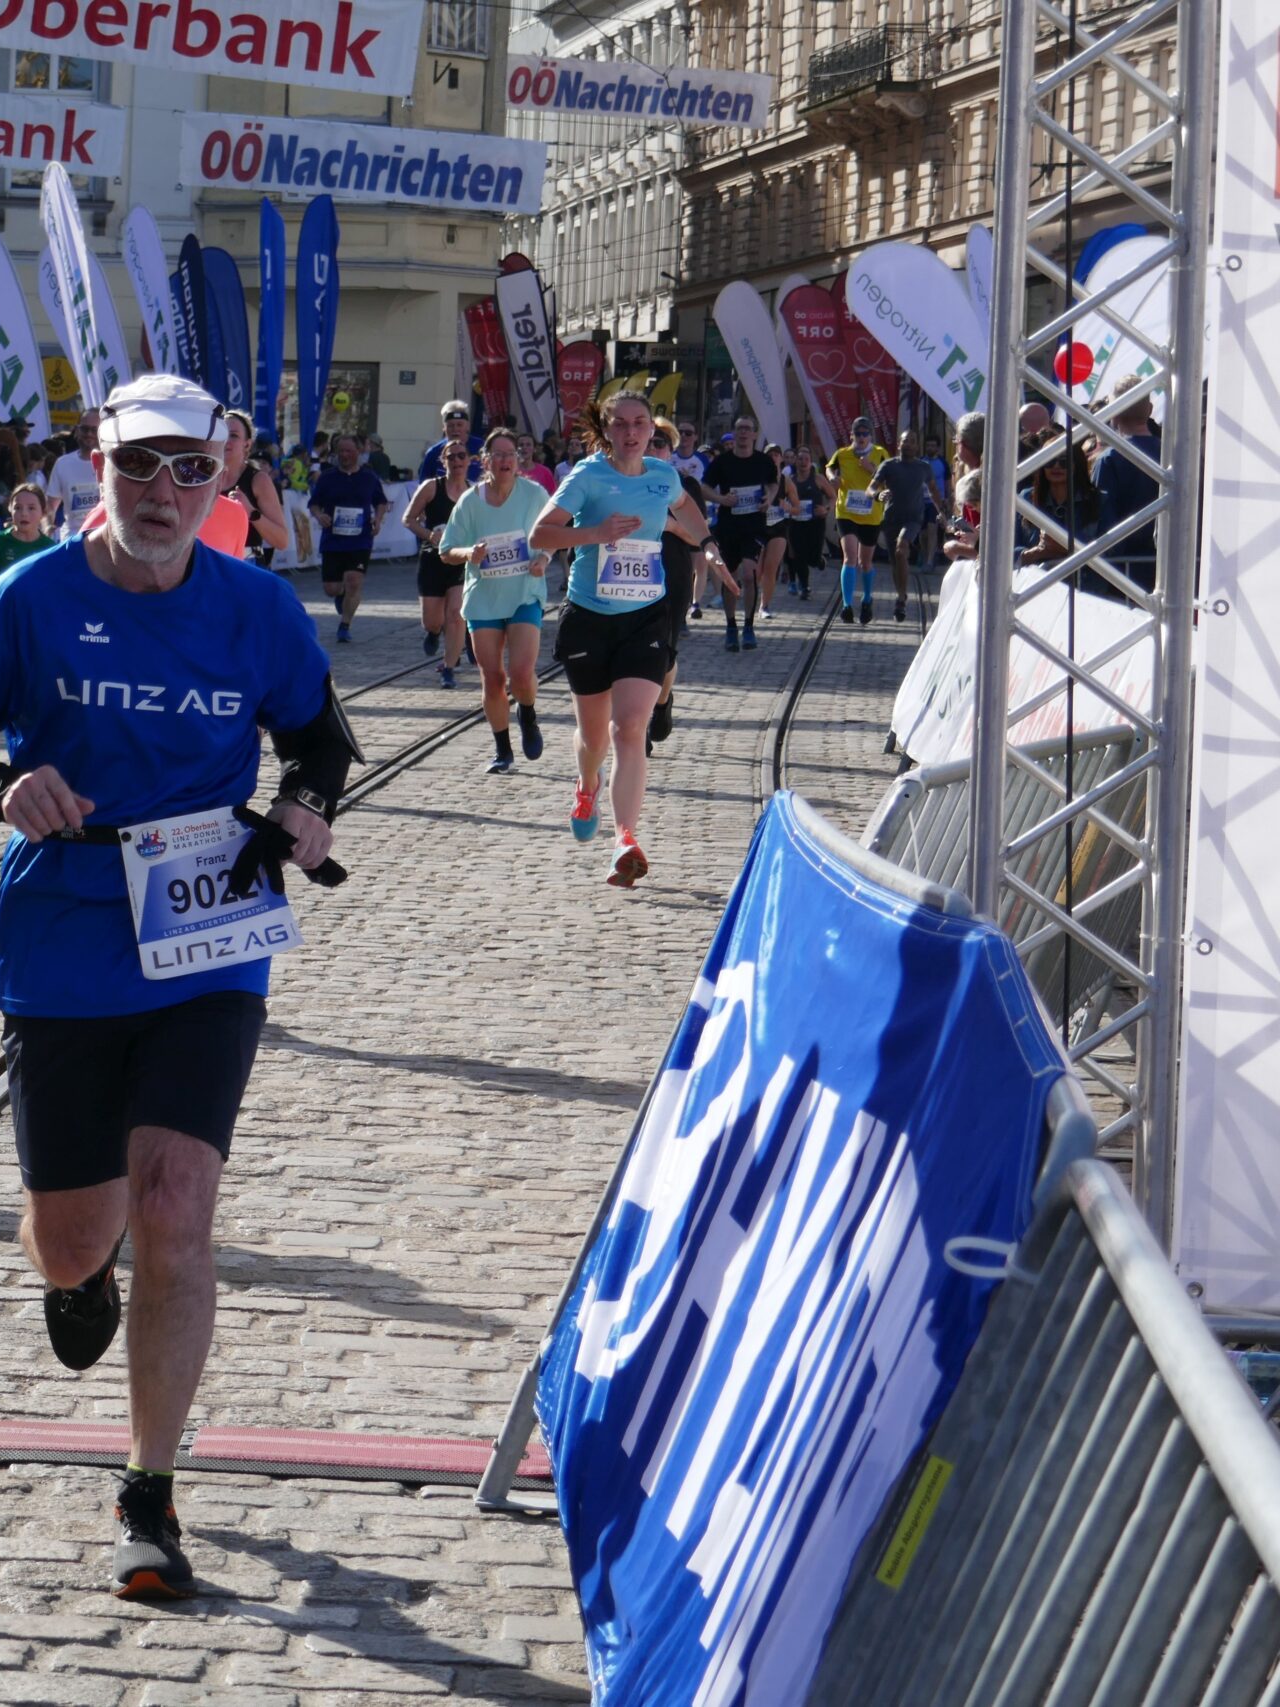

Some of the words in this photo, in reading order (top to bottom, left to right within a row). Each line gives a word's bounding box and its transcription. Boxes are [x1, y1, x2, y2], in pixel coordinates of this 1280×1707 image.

[508, 61, 754, 123] OÖNachrichten
[200, 122, 523, 205] OÖNachrichten
[562, 371, 592, 381] ORF
[485, 548, 520, 564] 13537
[613, 562, 650, 578] 9165
[601, 587, 635, 597] LINZ
[638, 590, 657, 598] AG
[79, 633, 110, 643] erima
[56, 678, 166, 712] LINZ
[176, 689, 243, 716] AG
[171, 828, 184, 836] 22.
[184, 821, 219, 834] Oberbank
[172, 835, 190, 843] LINZ
[193, 829, 221, 840] DONAU
[173, 836, 222, 850] MARATHON
[195, 853, 227, 868] Franz
[199, 904, 270, 929] VIERTELMARATHON
[152, 936, 237, 969] LINZ
[243, 924, 289, 951] AG
